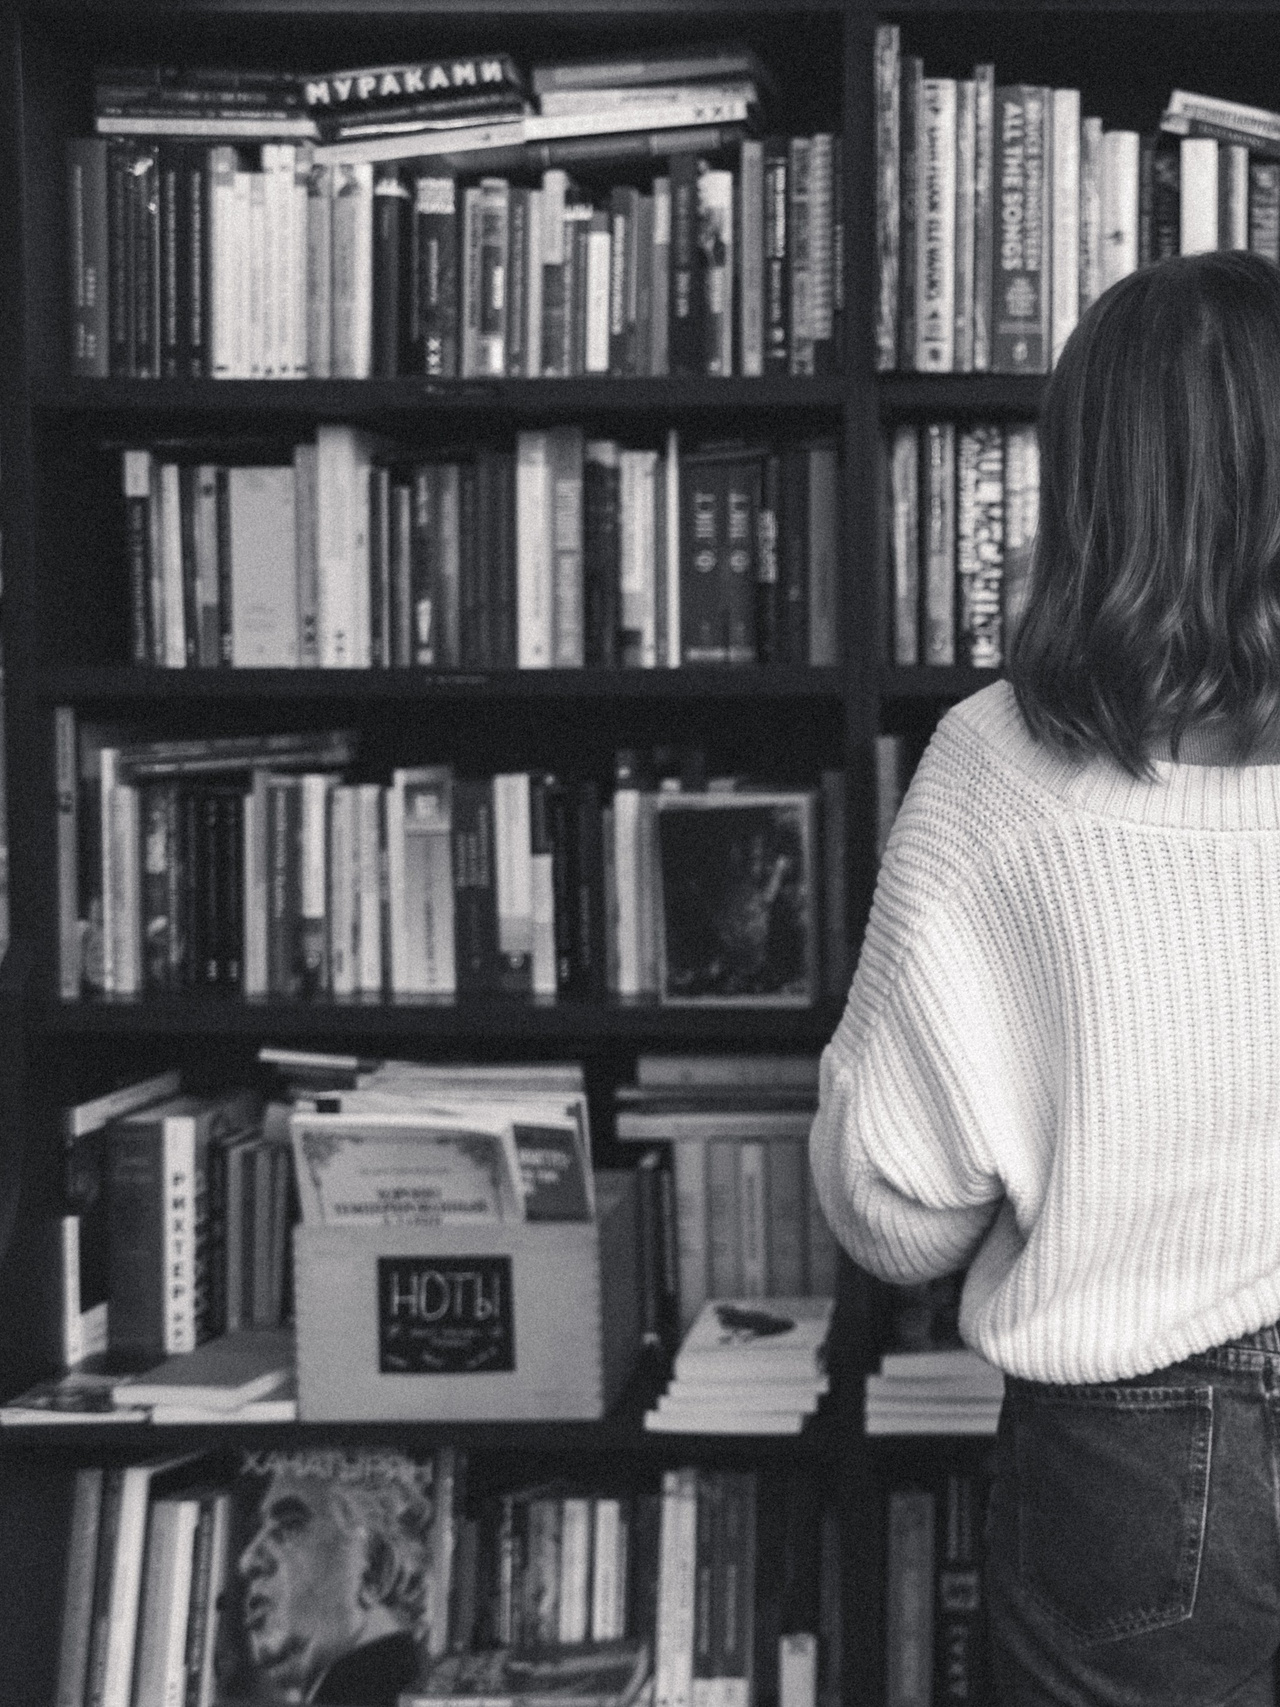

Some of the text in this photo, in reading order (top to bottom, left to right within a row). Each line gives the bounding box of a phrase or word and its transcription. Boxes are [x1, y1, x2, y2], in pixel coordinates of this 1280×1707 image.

[306, 59, 503, 106] МУРАКАМИ
[1003, 102, 1024, 270] ALL THE SONGS
[1025, 100, 1042, 271] BRUCE SPRINGSTEEN
[390, 1270, 501, 1321] НОТЫ
